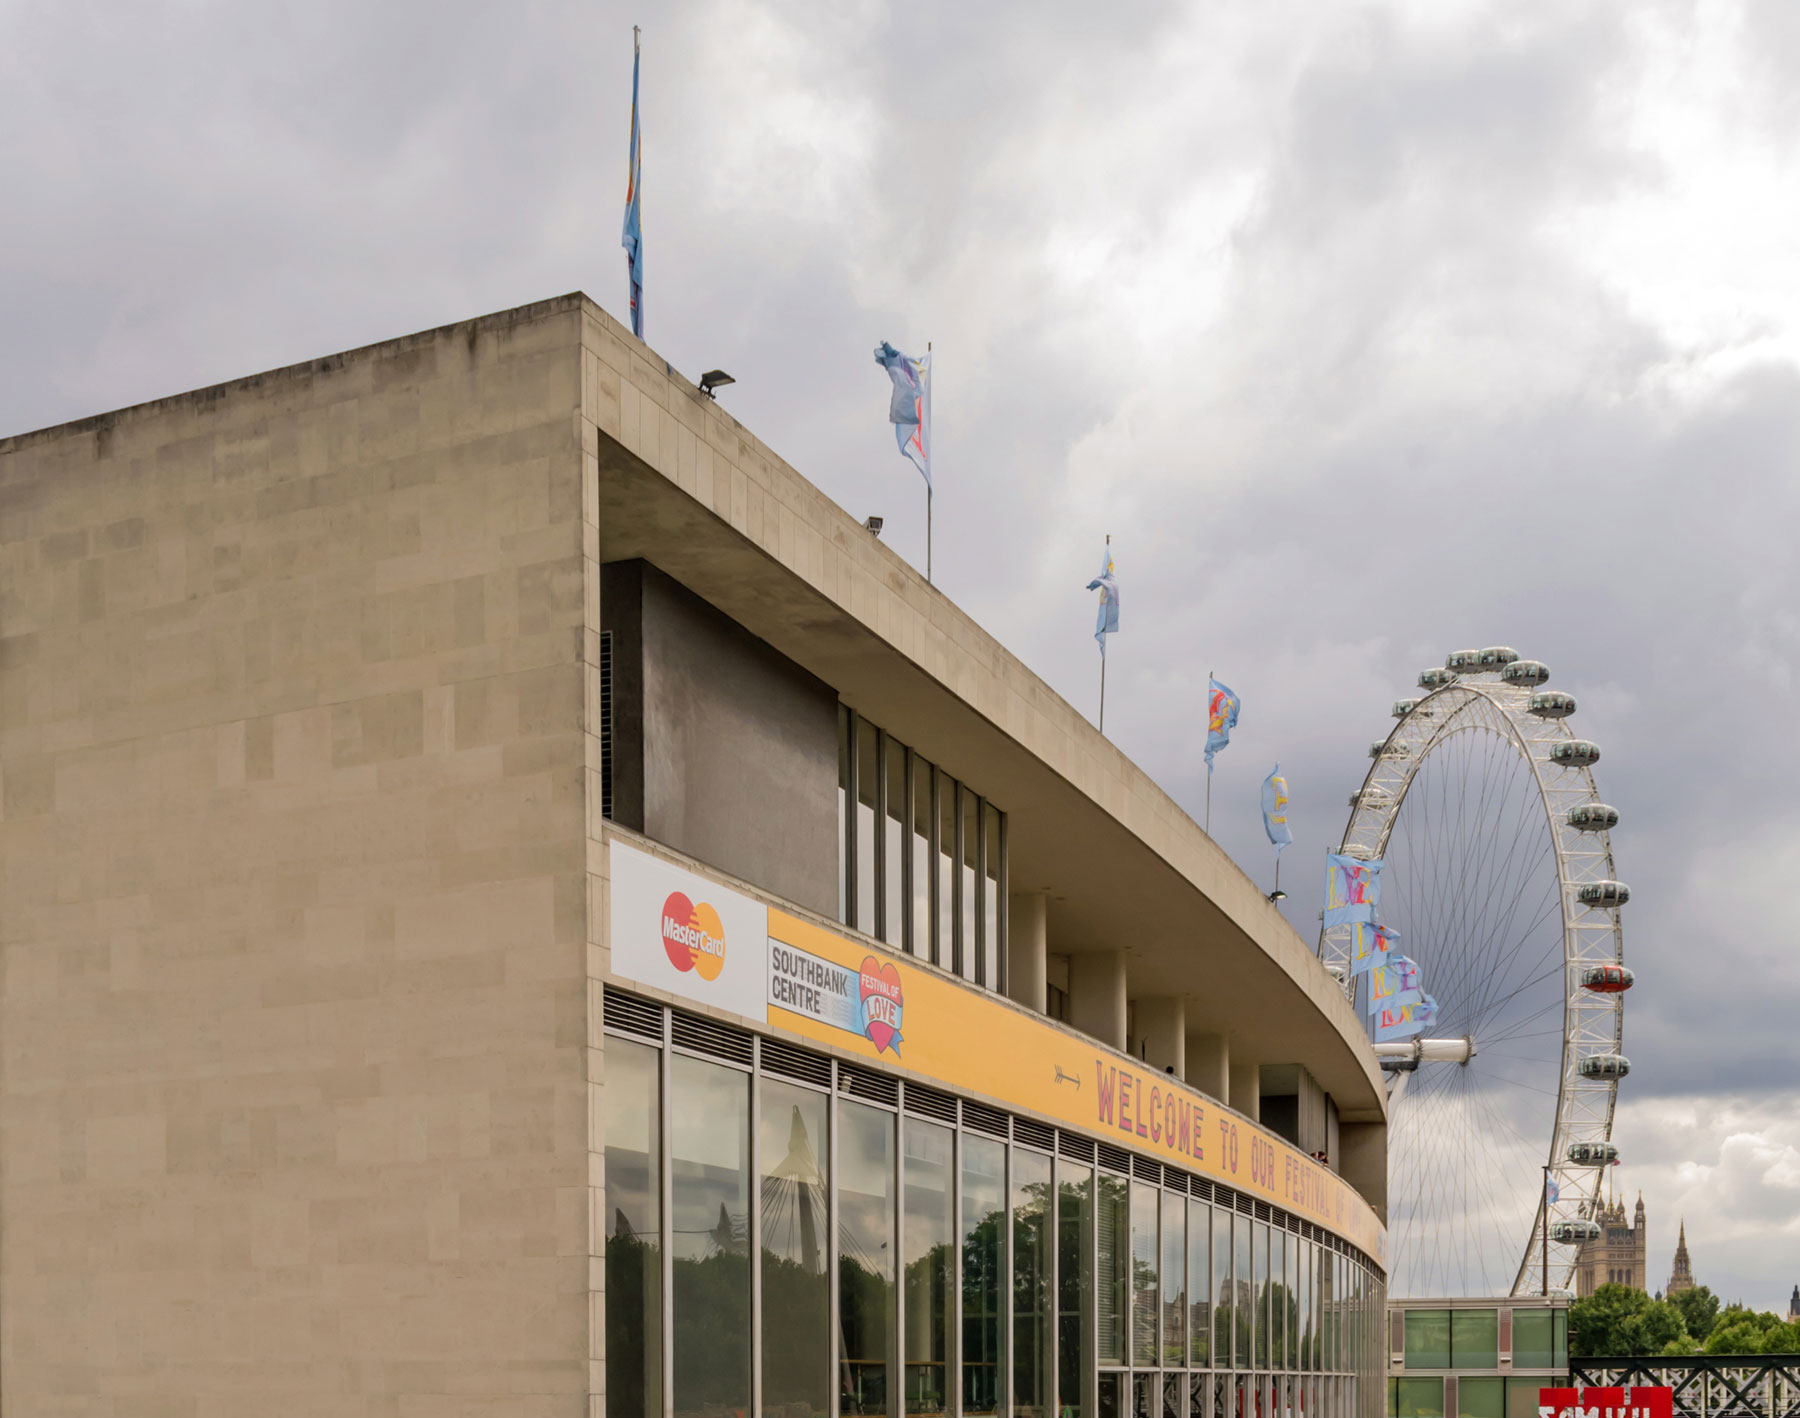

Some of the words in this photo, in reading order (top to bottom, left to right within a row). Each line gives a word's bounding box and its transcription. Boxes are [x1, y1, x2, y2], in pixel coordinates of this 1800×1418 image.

[663, 915, 724, 958] MasterCard
[773, 947, 848, 998] SOUTHBANK
[861, 973, 890, 996] FESTIVAL
[890, 985, 900, 998] OF
[773, 978, 821, 1015] CENTRE
[866, 997, 896, 1024] LOVE
[1096, 1060, 1204, 1161] WELCOME
[1220, 1118, 1238, 1175] TO
[1251, 1135, 1275, 1192] OUR
[1285, 1154, 1330, 1219] FESTIVAL
